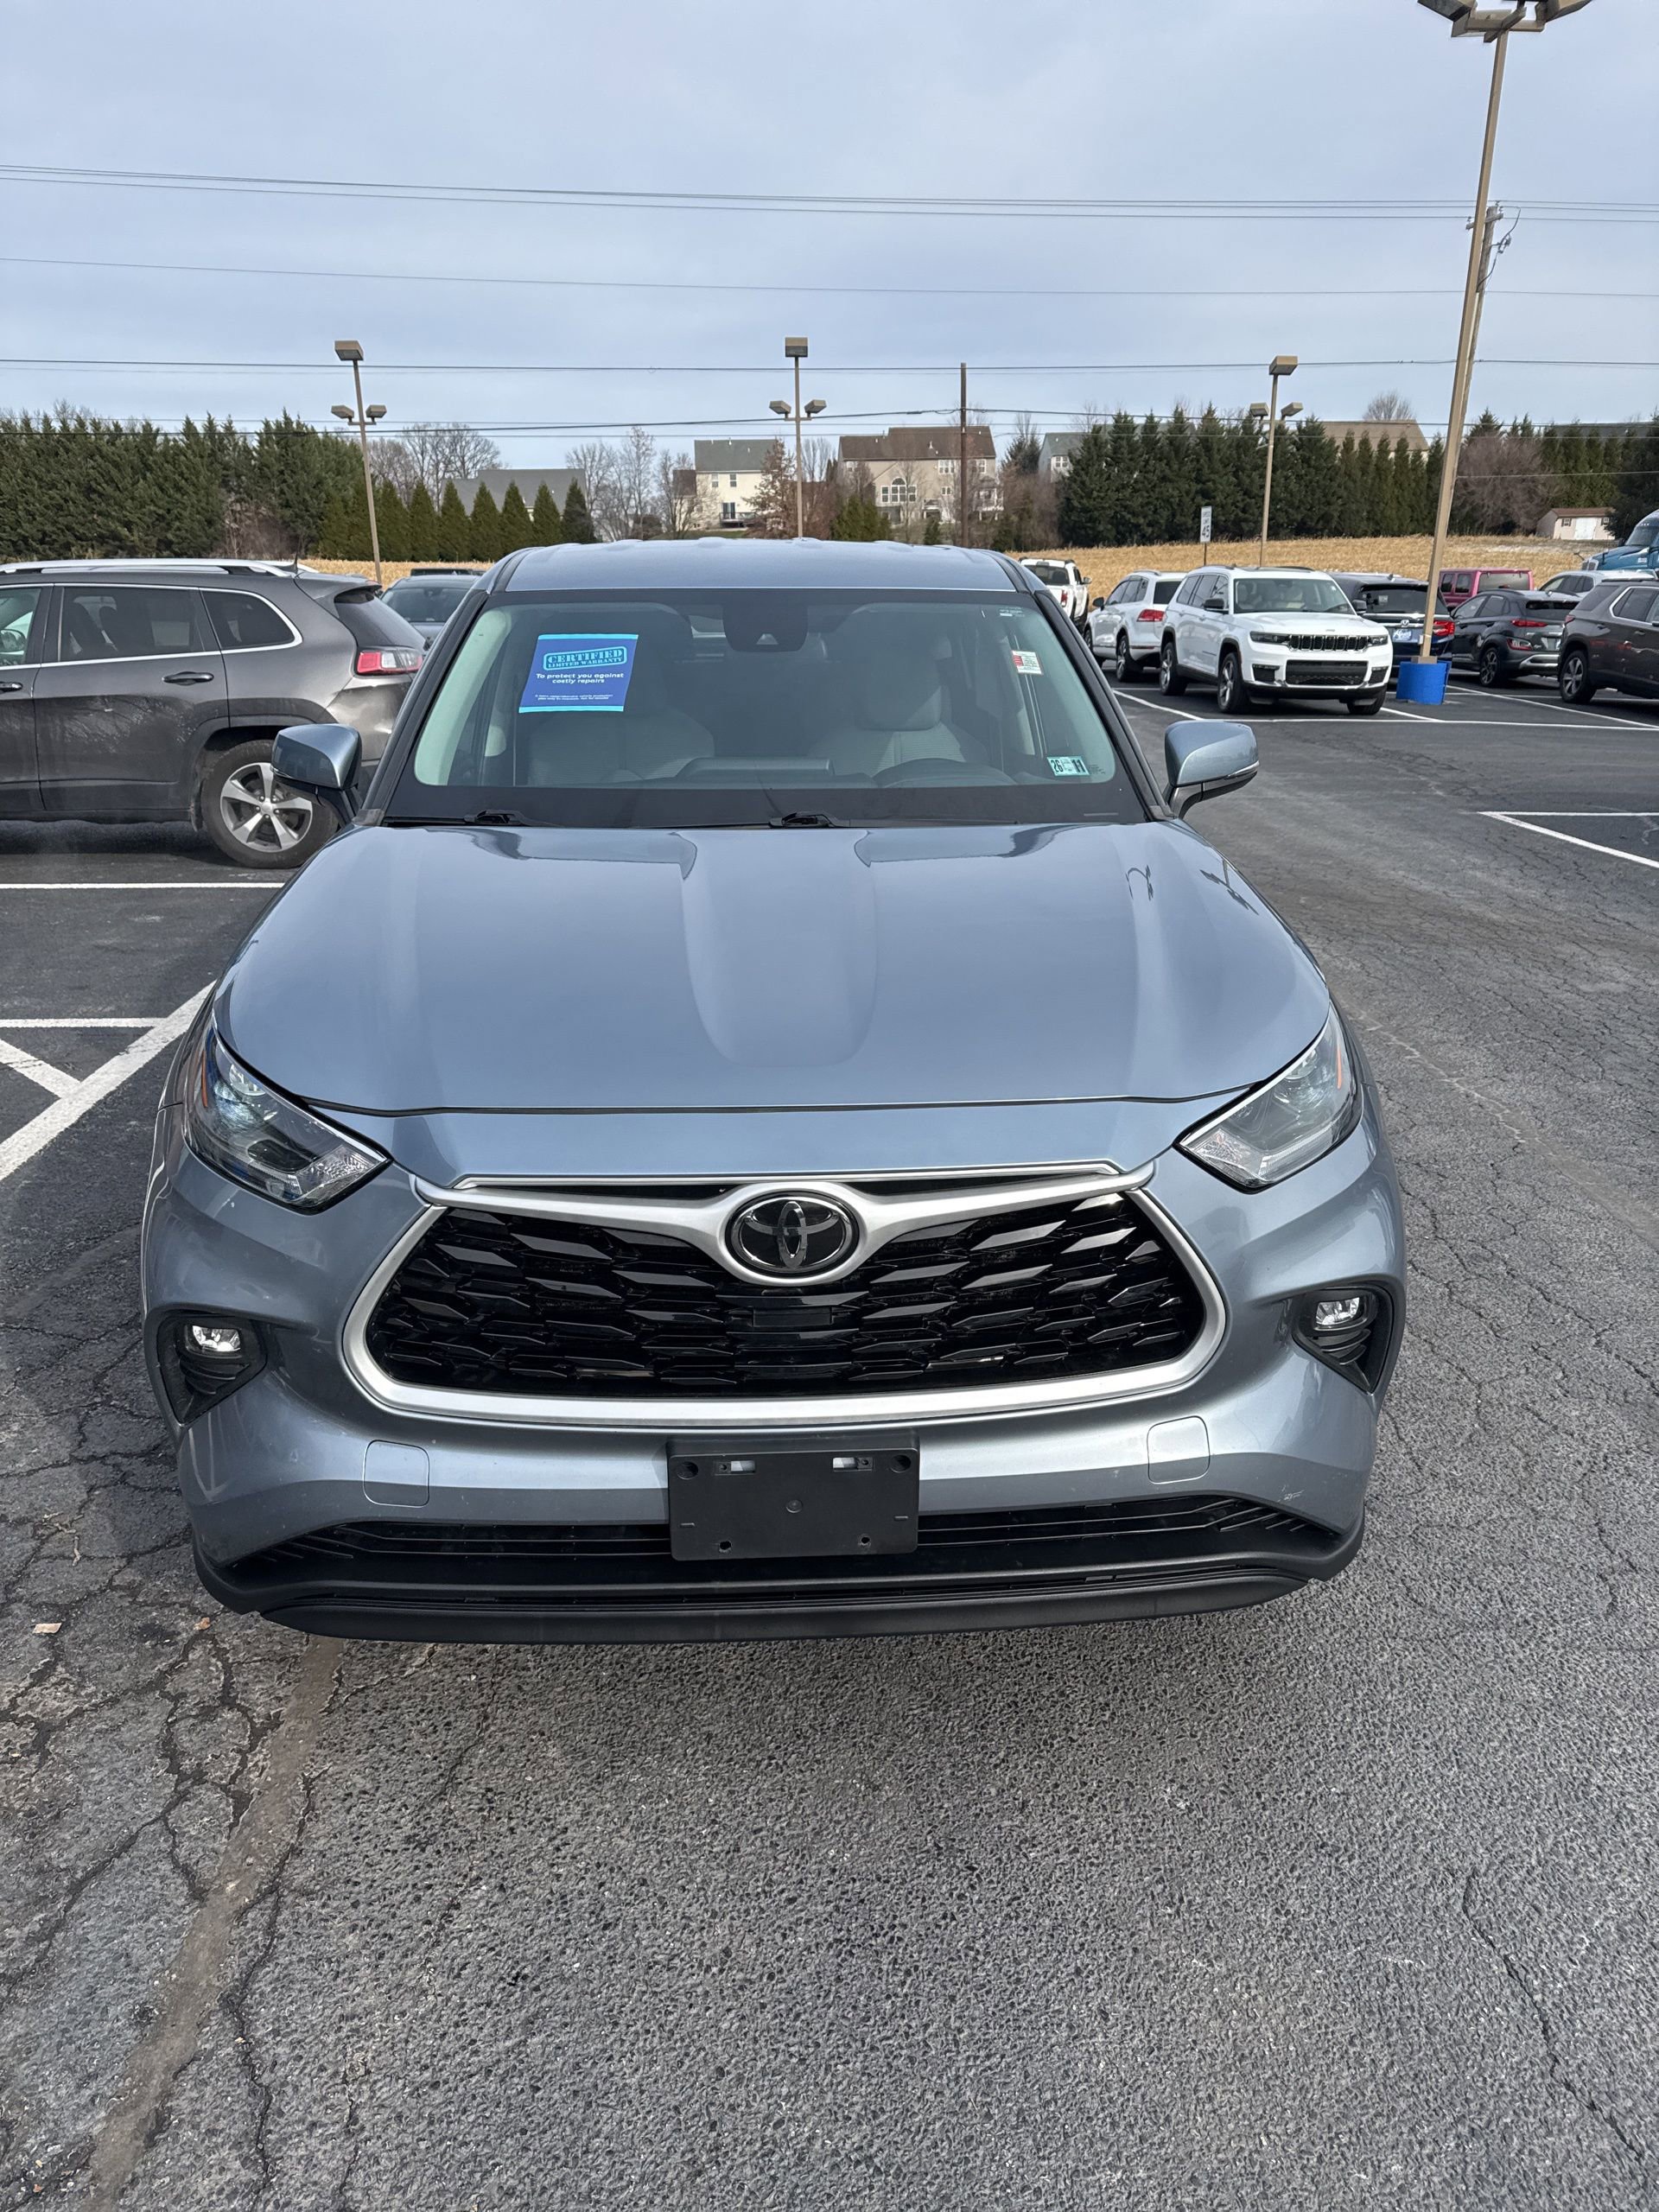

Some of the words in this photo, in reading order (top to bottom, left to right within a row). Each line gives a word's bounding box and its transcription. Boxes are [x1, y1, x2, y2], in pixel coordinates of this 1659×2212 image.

[1202, 524, 1210, 539] 45
[548, 650, 622, 663] CERTIFIED
[1051, 760, 1064, 772] 26
[1071, 760, 1085, 772] 11
